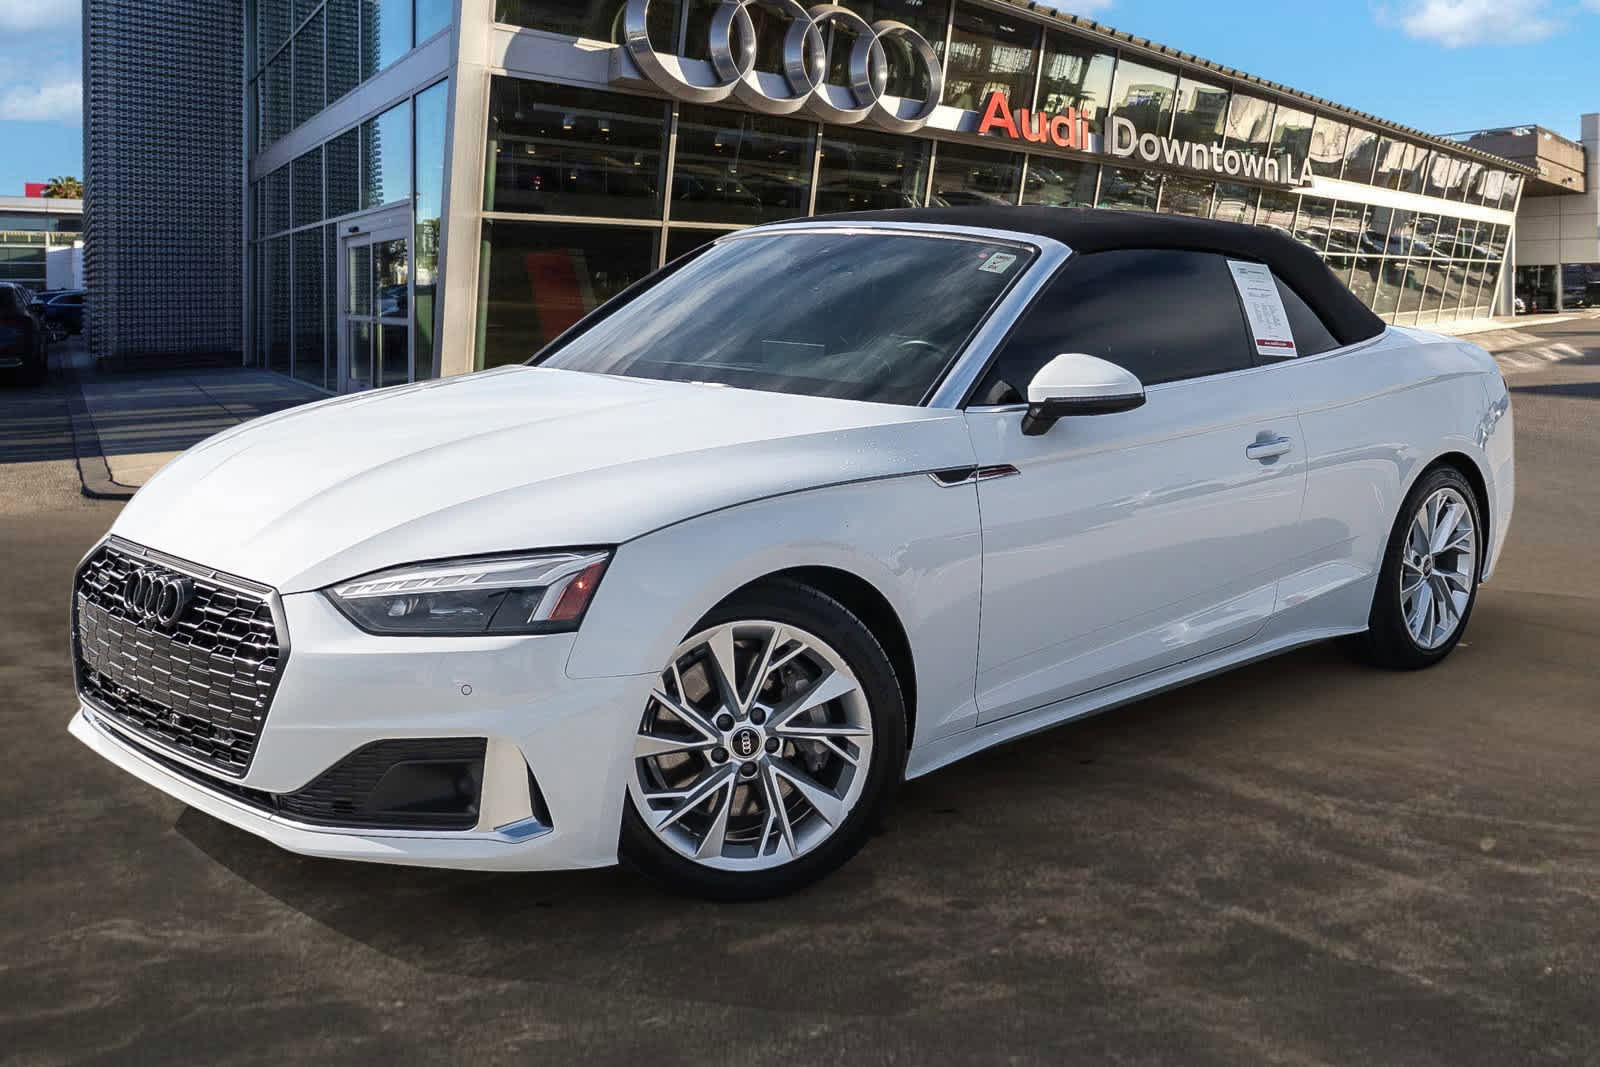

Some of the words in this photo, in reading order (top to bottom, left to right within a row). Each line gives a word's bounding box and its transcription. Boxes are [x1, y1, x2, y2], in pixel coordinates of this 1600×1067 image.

[978, 91, 1089, 150] Audi
[1109, 116, 1279, 182] Downtown
[1285, 153, 1315, 187] LA
